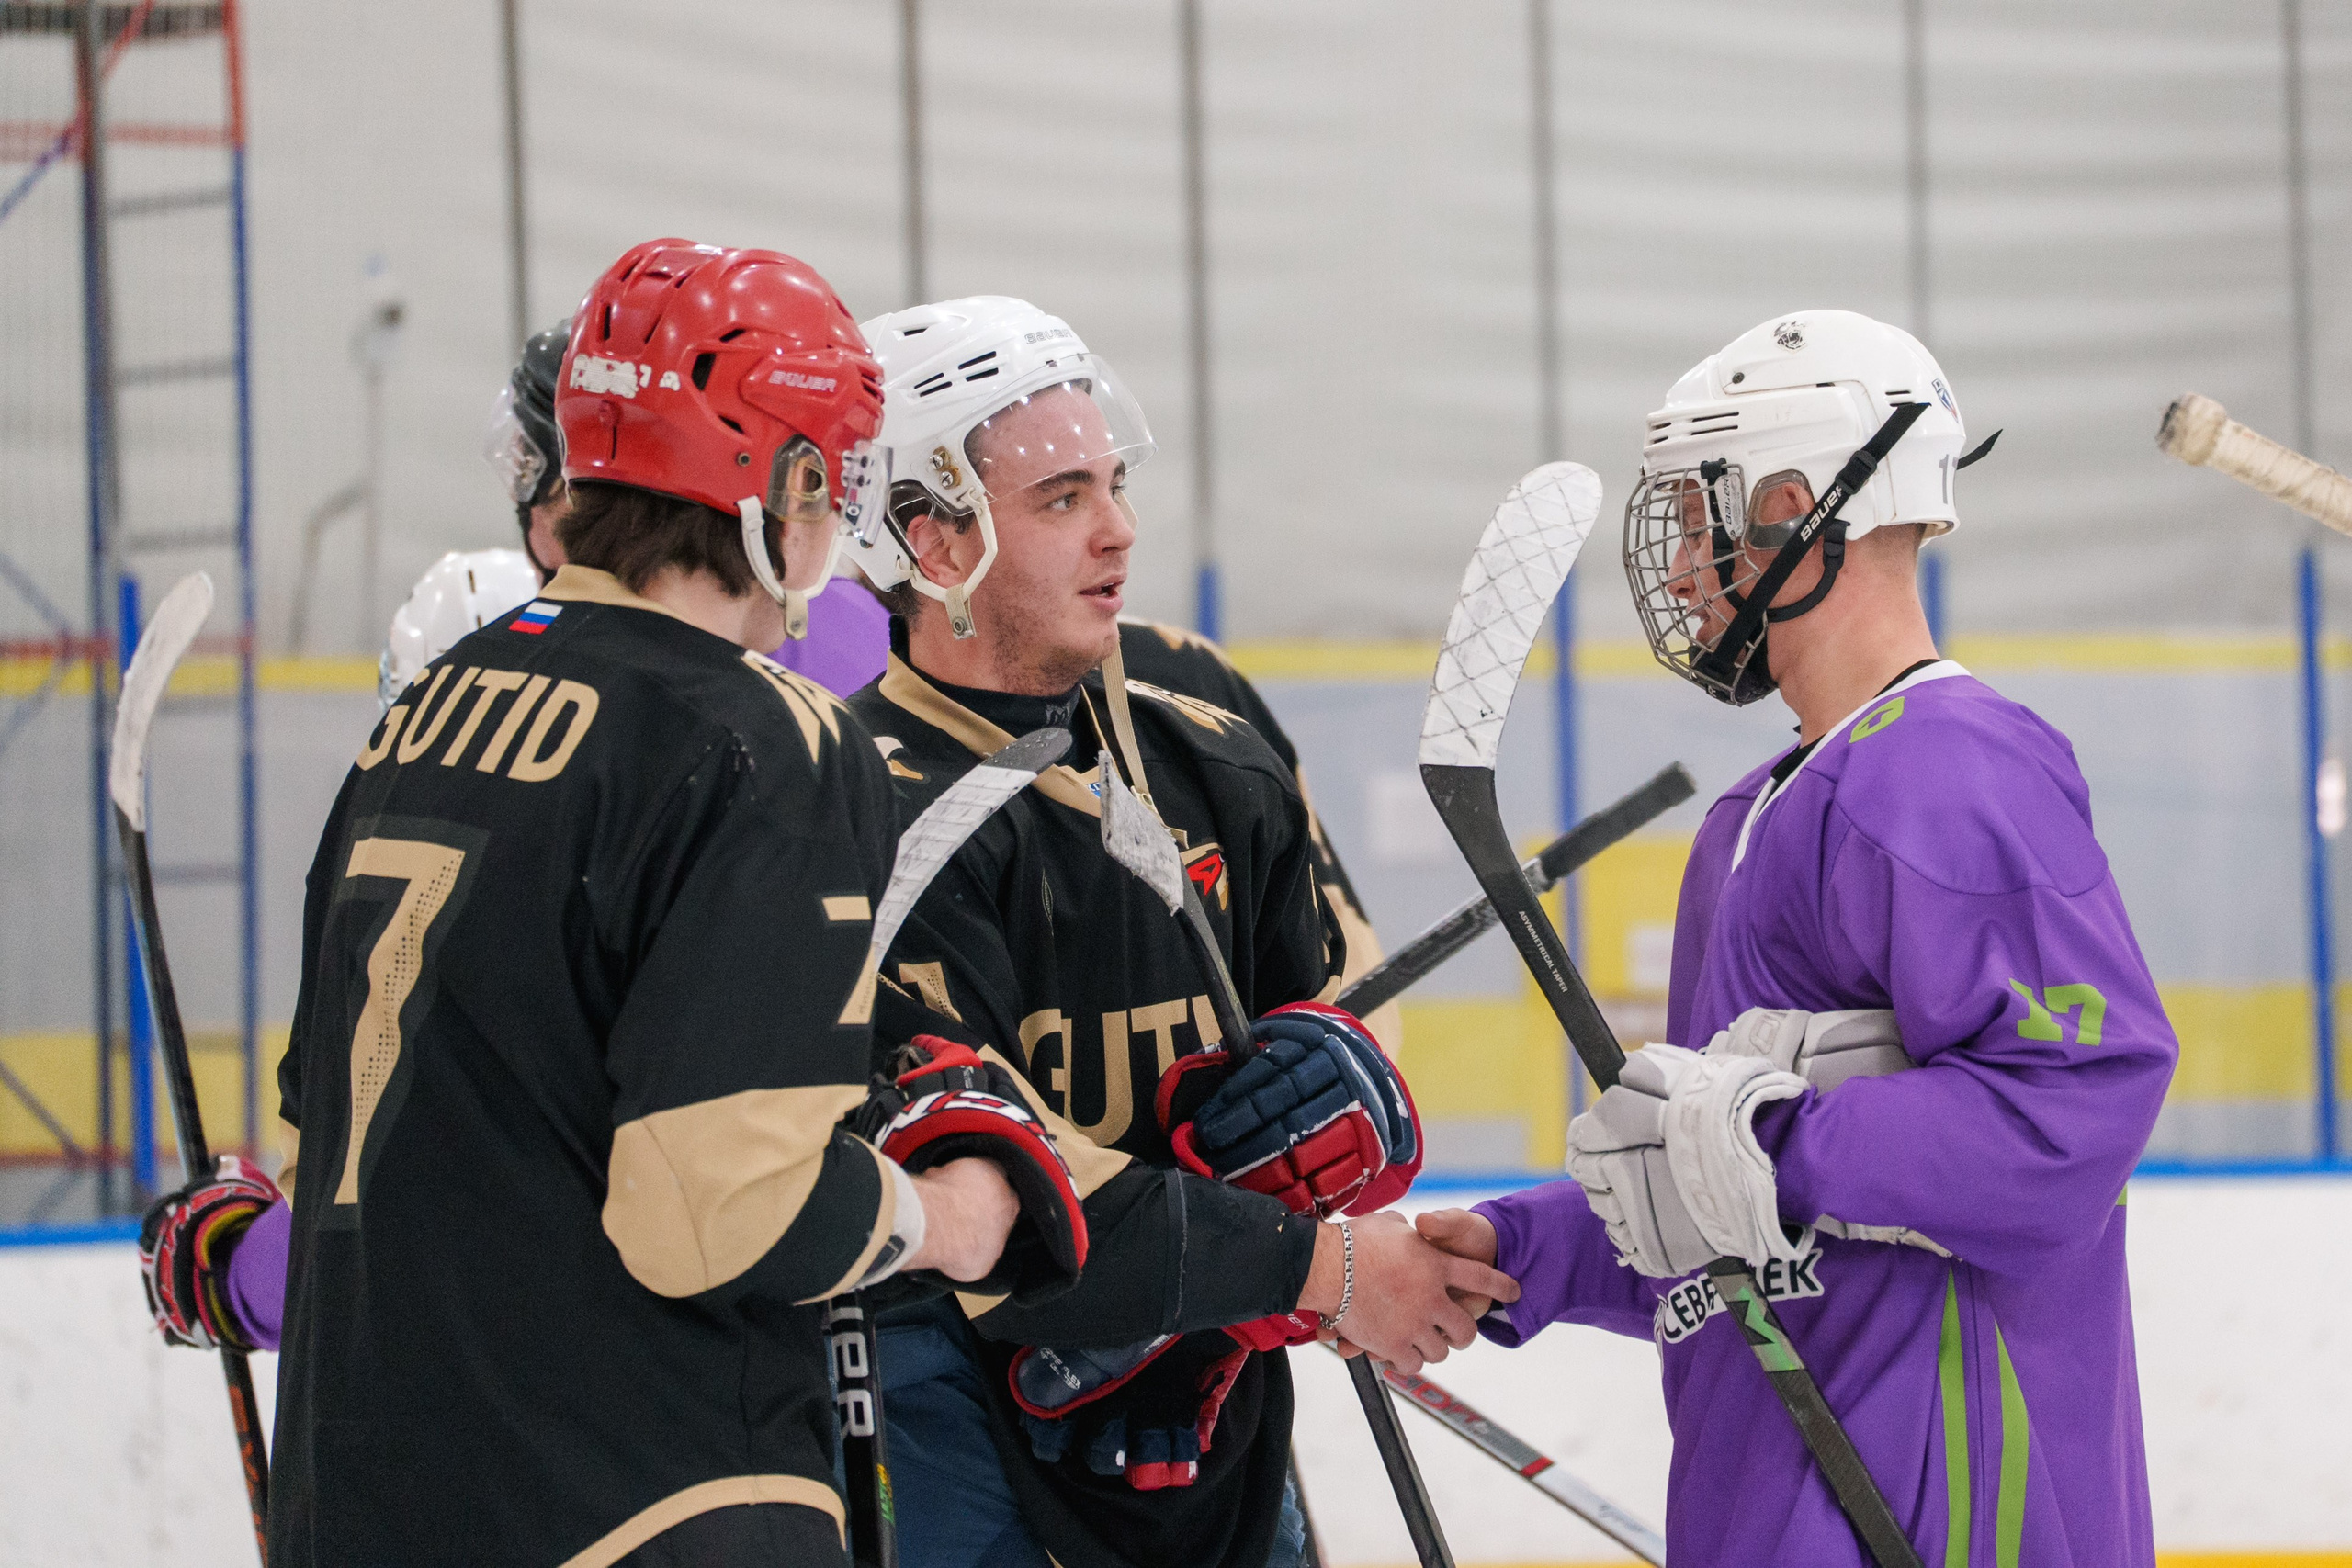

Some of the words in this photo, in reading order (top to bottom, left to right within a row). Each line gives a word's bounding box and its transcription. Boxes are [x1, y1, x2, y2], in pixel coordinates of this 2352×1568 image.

[356, 664, 597, 782] GUTID
[1518, 910, 1555, 970] ASYMMETRICAL
[1551, 968, 1569, 993] TAPER
[334, 837, 466, 1205] 7
[2008, 977, 2108, 1046] 17
